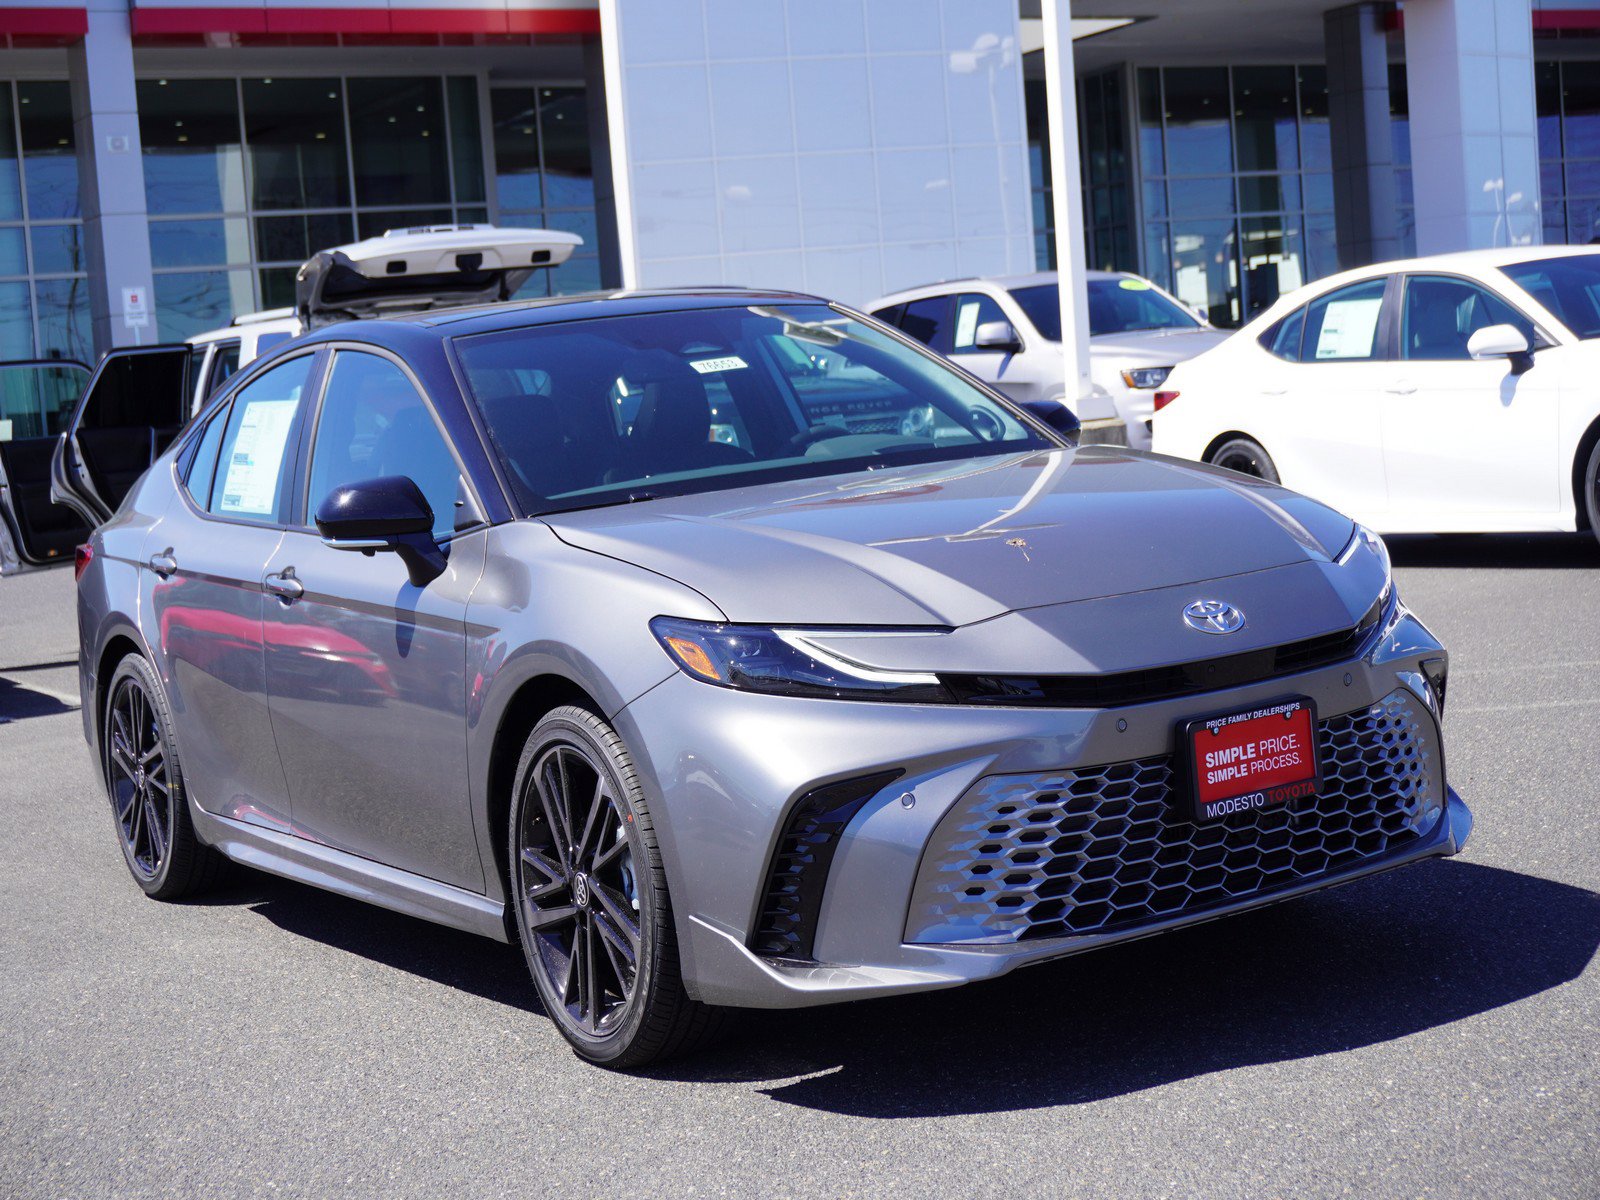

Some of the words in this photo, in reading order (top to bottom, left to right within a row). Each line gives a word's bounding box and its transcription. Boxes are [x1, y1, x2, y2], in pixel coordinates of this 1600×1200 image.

[810, 405, 840, 414] NGE
[847, 400, 893, 411] ROVER
[1206, 718, 1227, 729] PRICE
[1228, 712, 1252, 724] FAMILY
[1253, 702, 1300, 719] DEALERSHIPS
[1205, 743, 1256, 769] SIMPLE
[1259, 733, 1300, 756] PRICE.
[1207, 763, 1248, 785] SIMPLE
[1250, 752, 1302, 774] PROCESS.
[1206, 792, 1264, 818] MODESTO
[1267, 781, 1316, 803] TOYOTA
